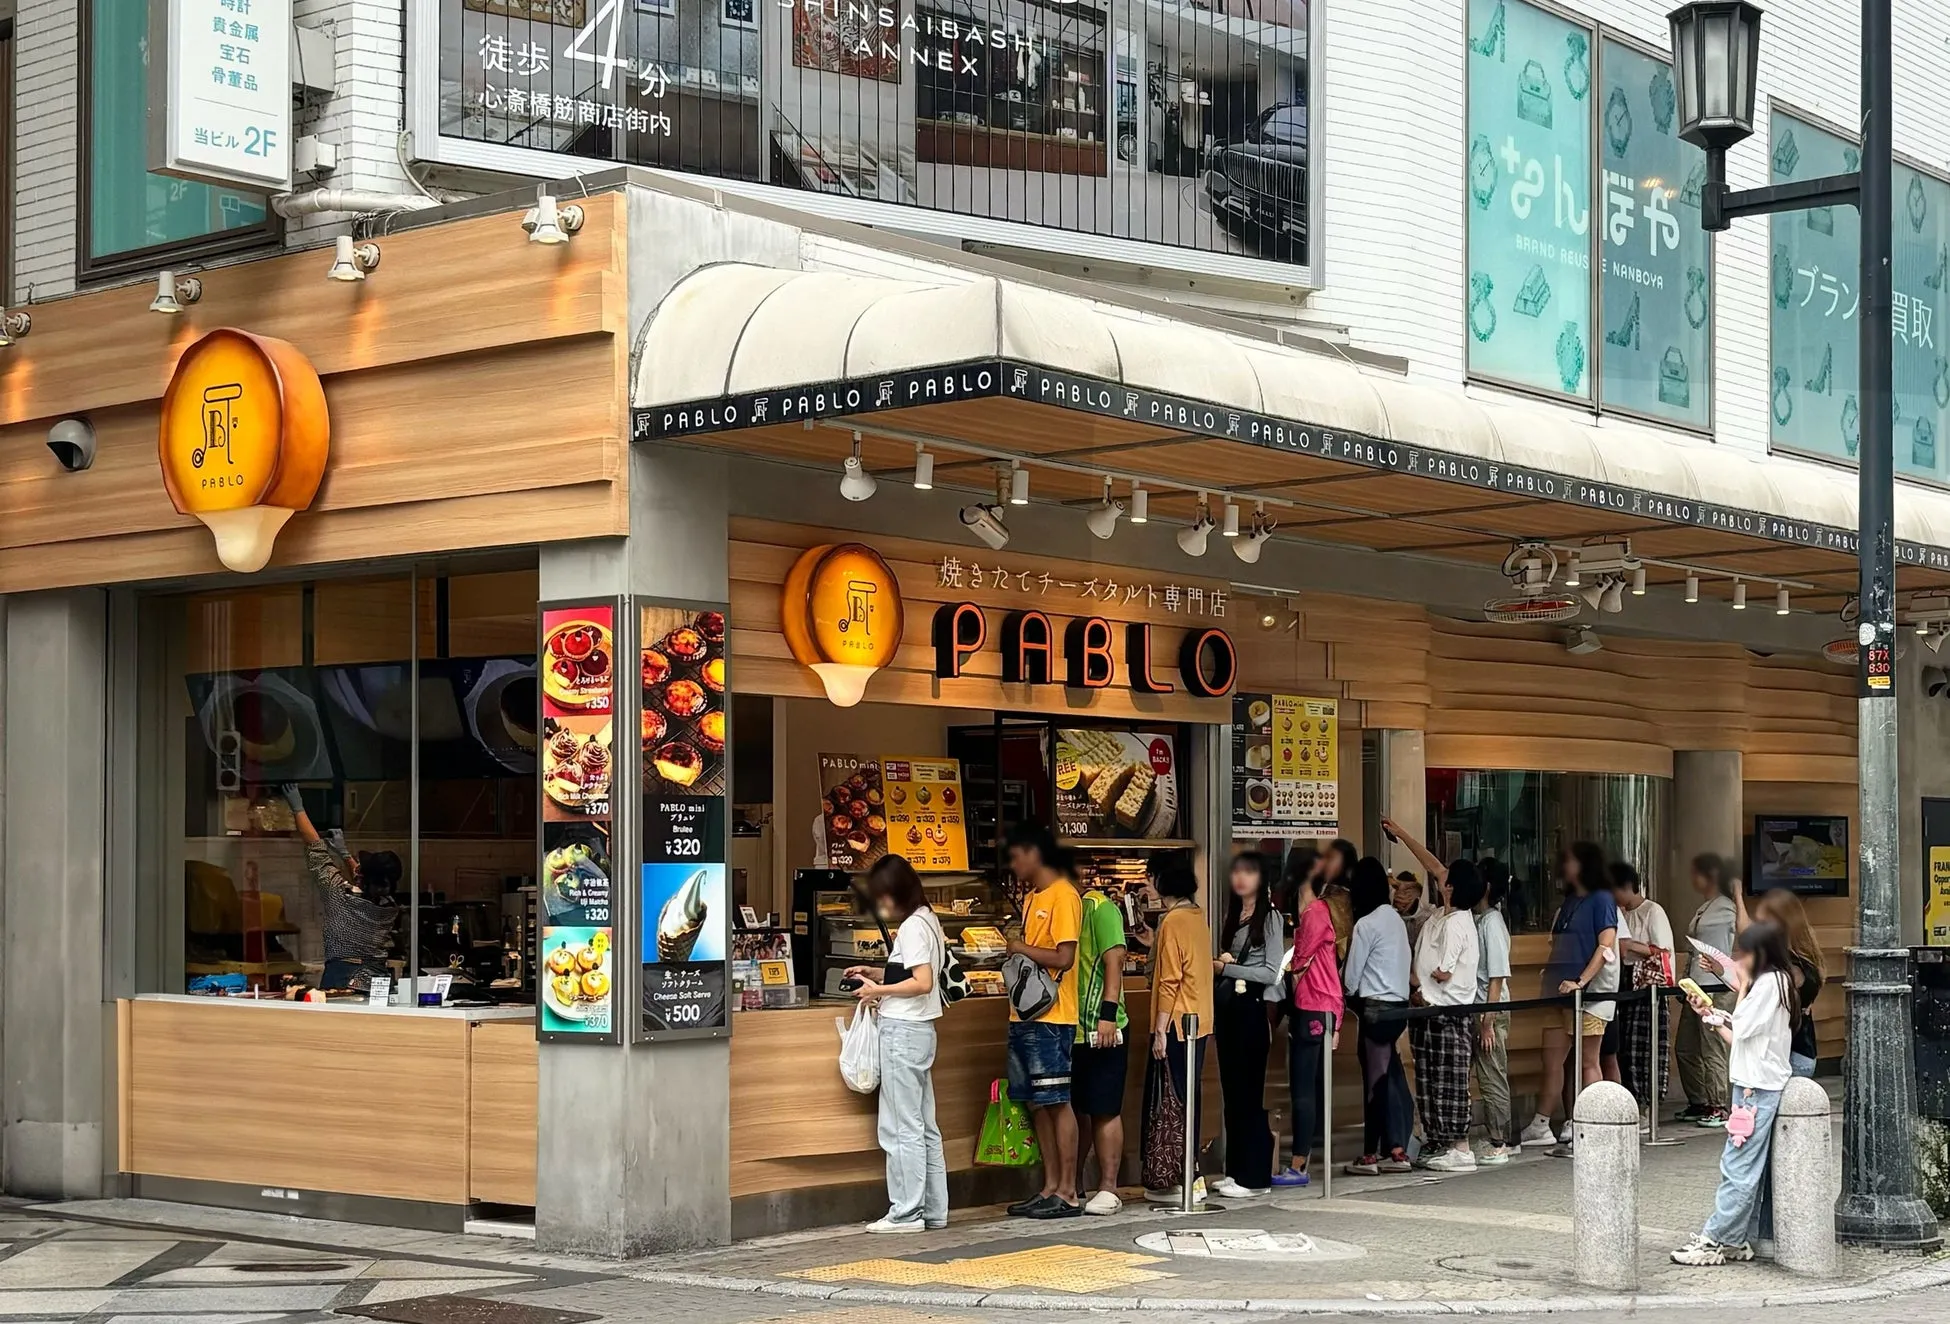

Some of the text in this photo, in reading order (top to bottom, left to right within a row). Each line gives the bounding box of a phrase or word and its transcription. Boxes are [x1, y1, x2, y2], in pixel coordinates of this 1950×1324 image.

[212, 16, 260, 42] 貴金属
[220, 44, 251, 65] 宝石
[478, 0, 672, 99] 徒歩 4 分
[852, 37, 979, 76] ANNEX
[211, 66, 259, 92] 骨董品
[478, 82, 672, 137] 心斎橋筋商店街内
[194, 126, 277, 157] 当ビル 2F
[1516, 234, 1555, 259] BRAND
[1613, 262, 1664, 290] NANBOYA
[1797, 264, 1934, 350] ブラン買取
[909, 370, 992, 400] PABLO
[1041, 378, 1111, 410] PABLO
[783, 389, 860, 417] PABLO
[1151, 401, 1215, 430] PABLO
[664, 405, 737, 432] PABLO
[1251, 421, 1310, 448] PABLO
[1343, 440, 1398, 466] PABLO
[201, 474, 244, 489] PABLO
[1428, 457, 1479, 481] PABLO
[1507, 472, 1554, 494] PABLO
[1581, 486, 1625, 507] PABLO
[1649, 499, 1690, 520] PABLO
[1712, 511, 1751, 531] PABLO
[1772, 522, 1809, 541] PABLO
[940, 555, 1229, 618] 焼きたてチーズタルト専門店
[842, 639, 875, 651] PABLO
[932, 601, 1238, 698] PABLO
[822, 758, 858, 769] PABLO
[1057, 761, 1077, 775] REE
[660, 803, 686, 812] PABLO
[665, 838, 701, 856] ¥320
[665, 1004, 700, 1022] ¥500
